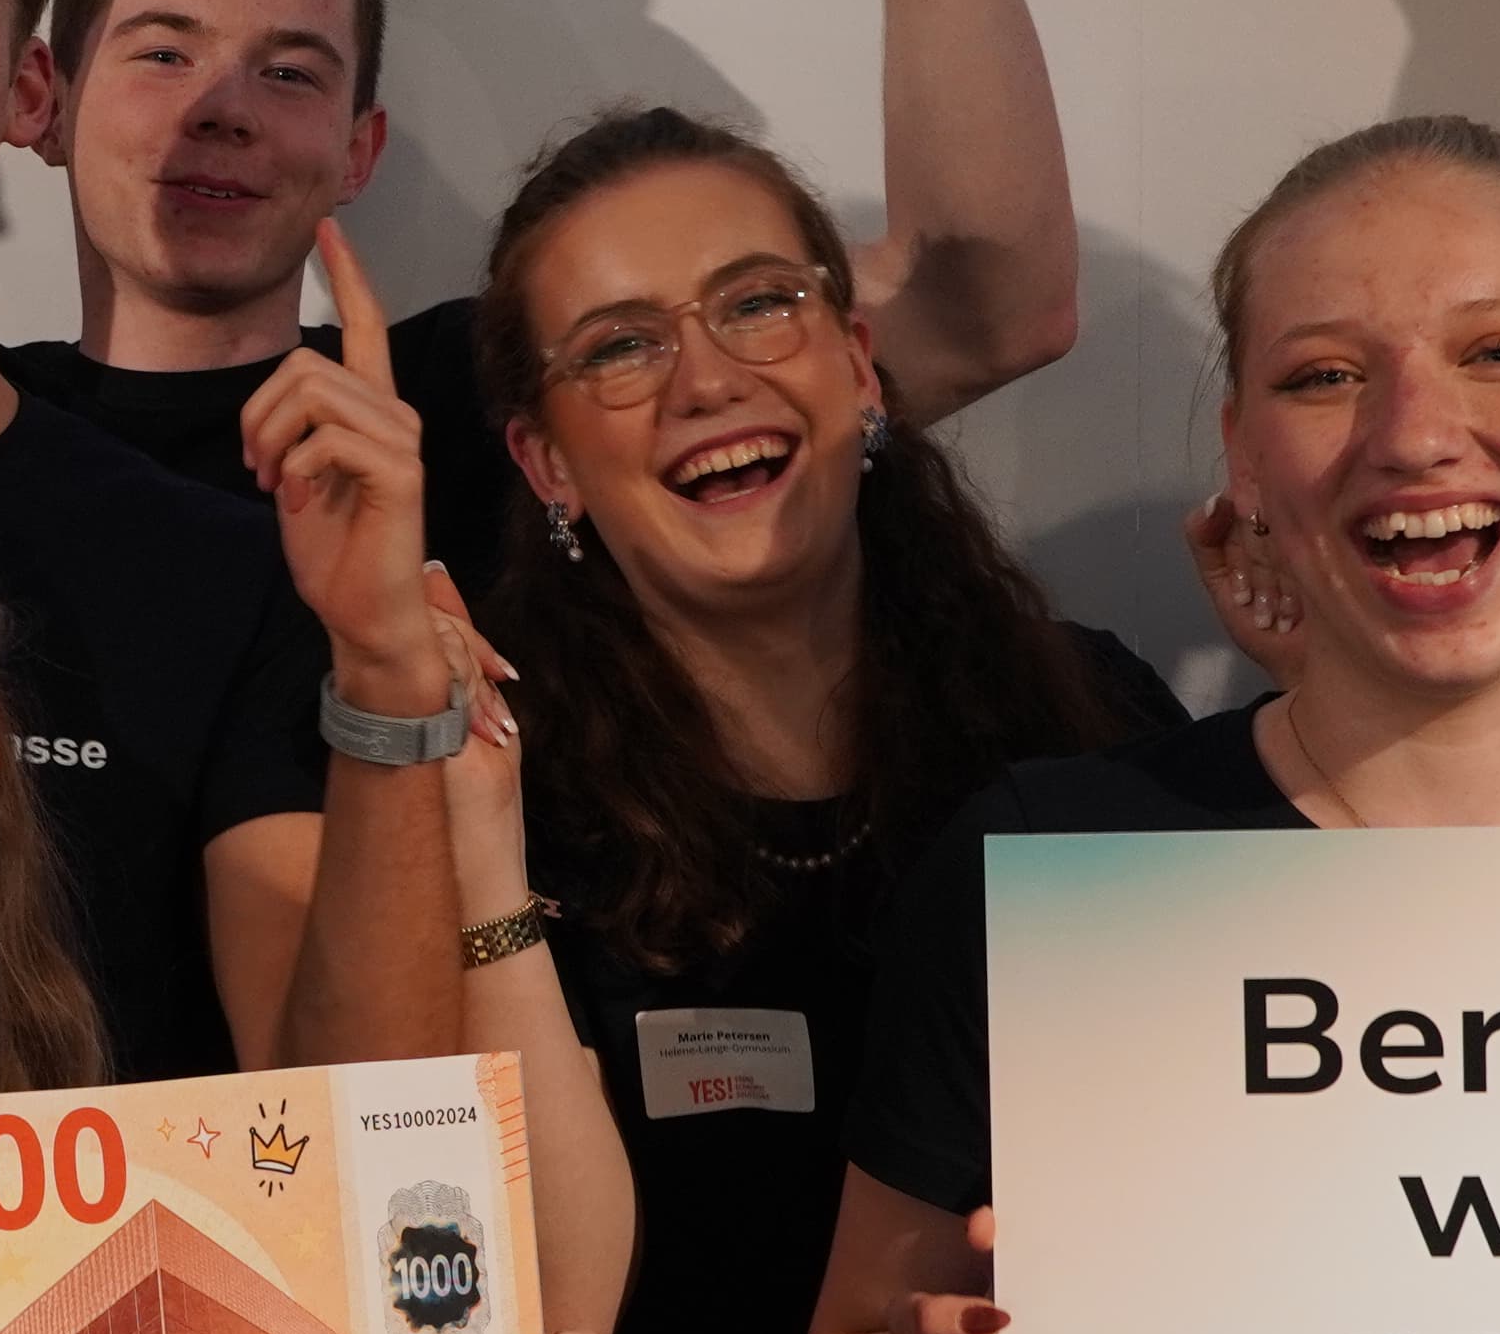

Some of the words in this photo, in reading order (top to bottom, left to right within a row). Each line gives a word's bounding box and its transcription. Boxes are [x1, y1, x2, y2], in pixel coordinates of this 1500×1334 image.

[677, 1032, 714, 1045] Marie
[688, 1077, 734, 1105] YES!
[360, 1106, 478, 1132] YES10002024
[393, 1252, 473, 1300] 1000
